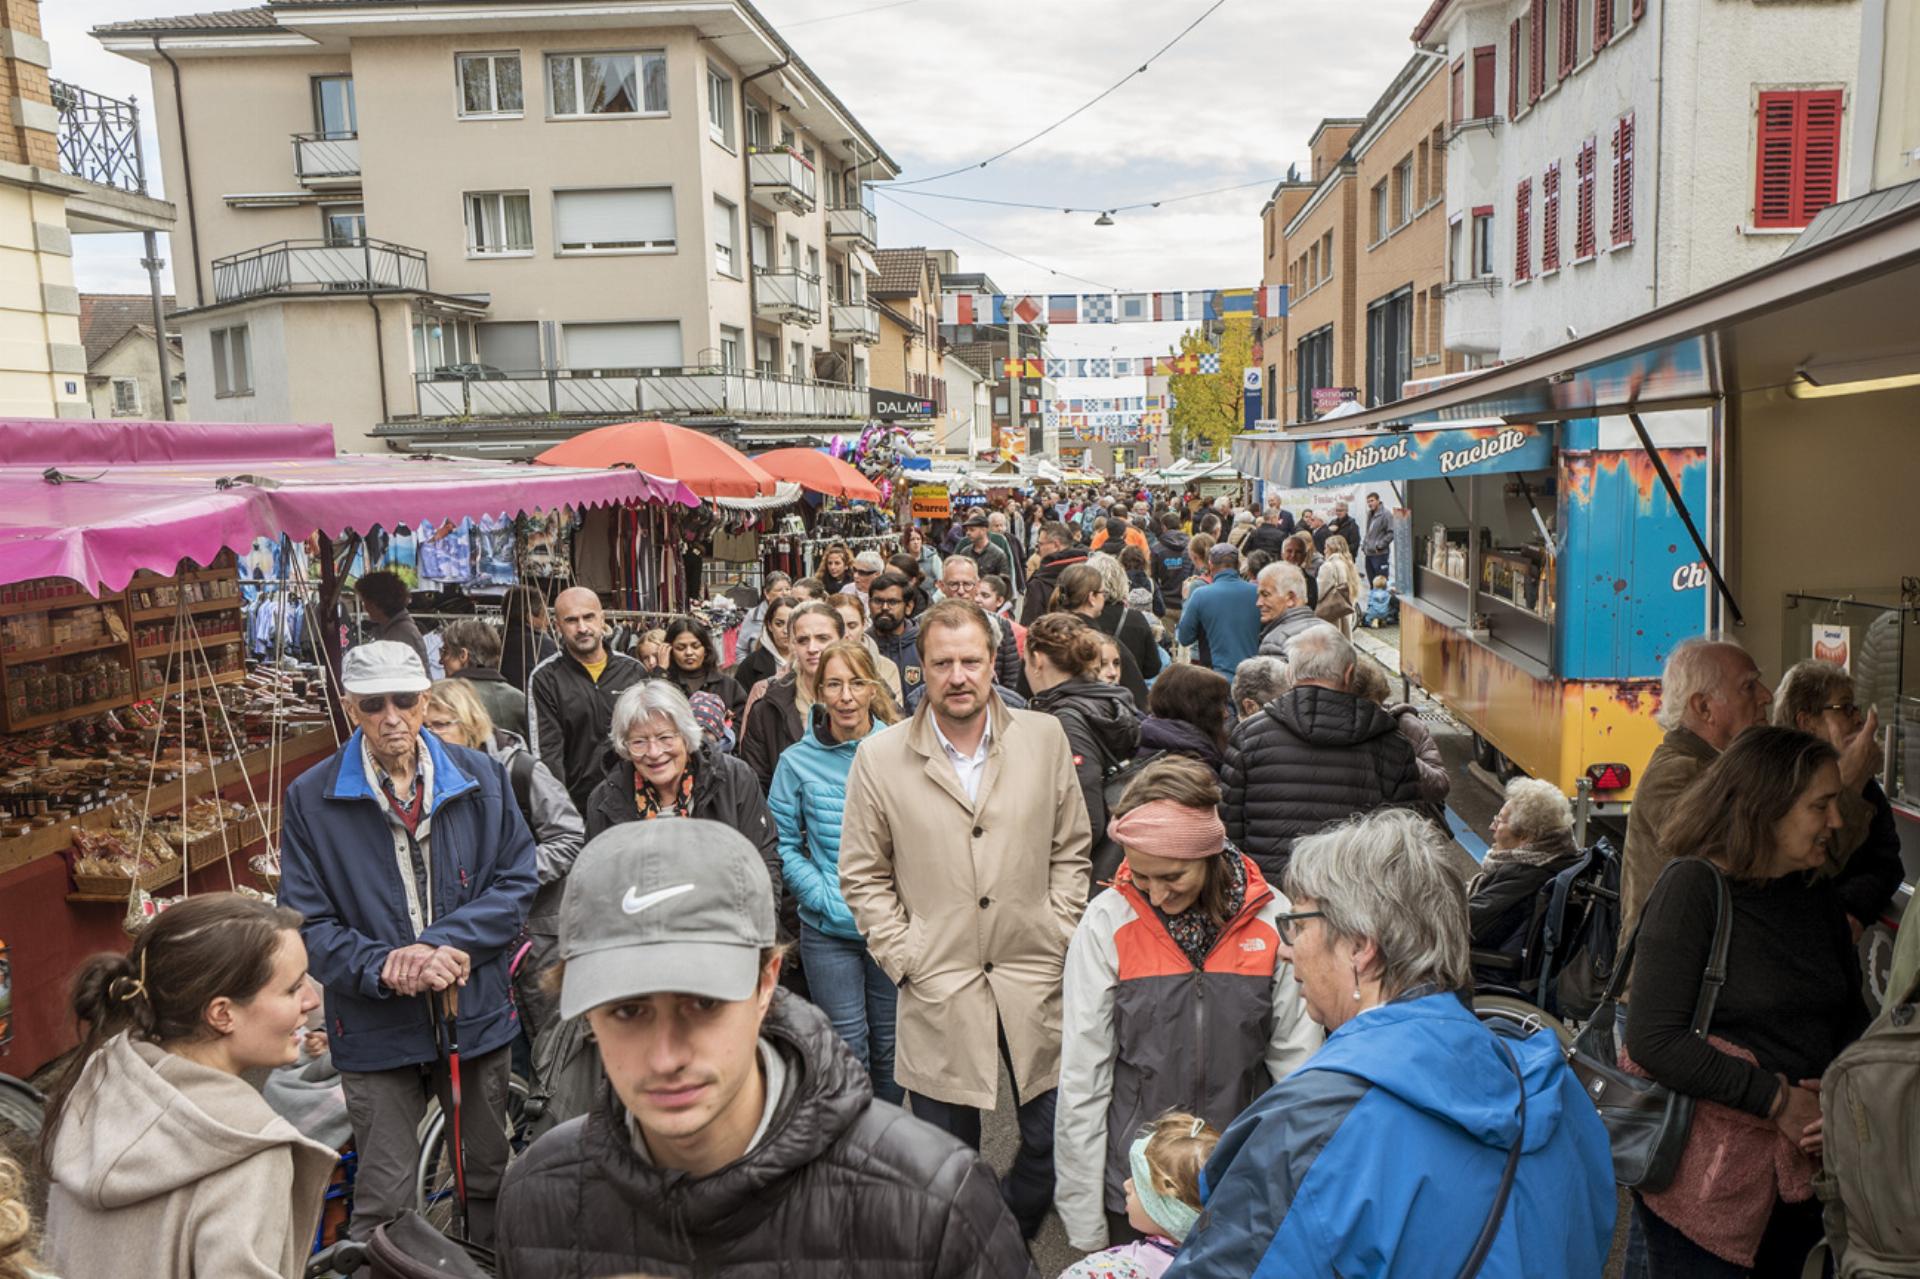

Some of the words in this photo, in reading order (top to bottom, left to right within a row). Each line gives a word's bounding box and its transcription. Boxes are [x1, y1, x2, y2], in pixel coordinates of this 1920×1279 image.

[1306, 437, 1408, 485] Knoblibrot
[1439, 429, 1526, 474] Raclette
[913, 502, 948, 513] Churros
[1671, 561, 1707, 592] Ch
